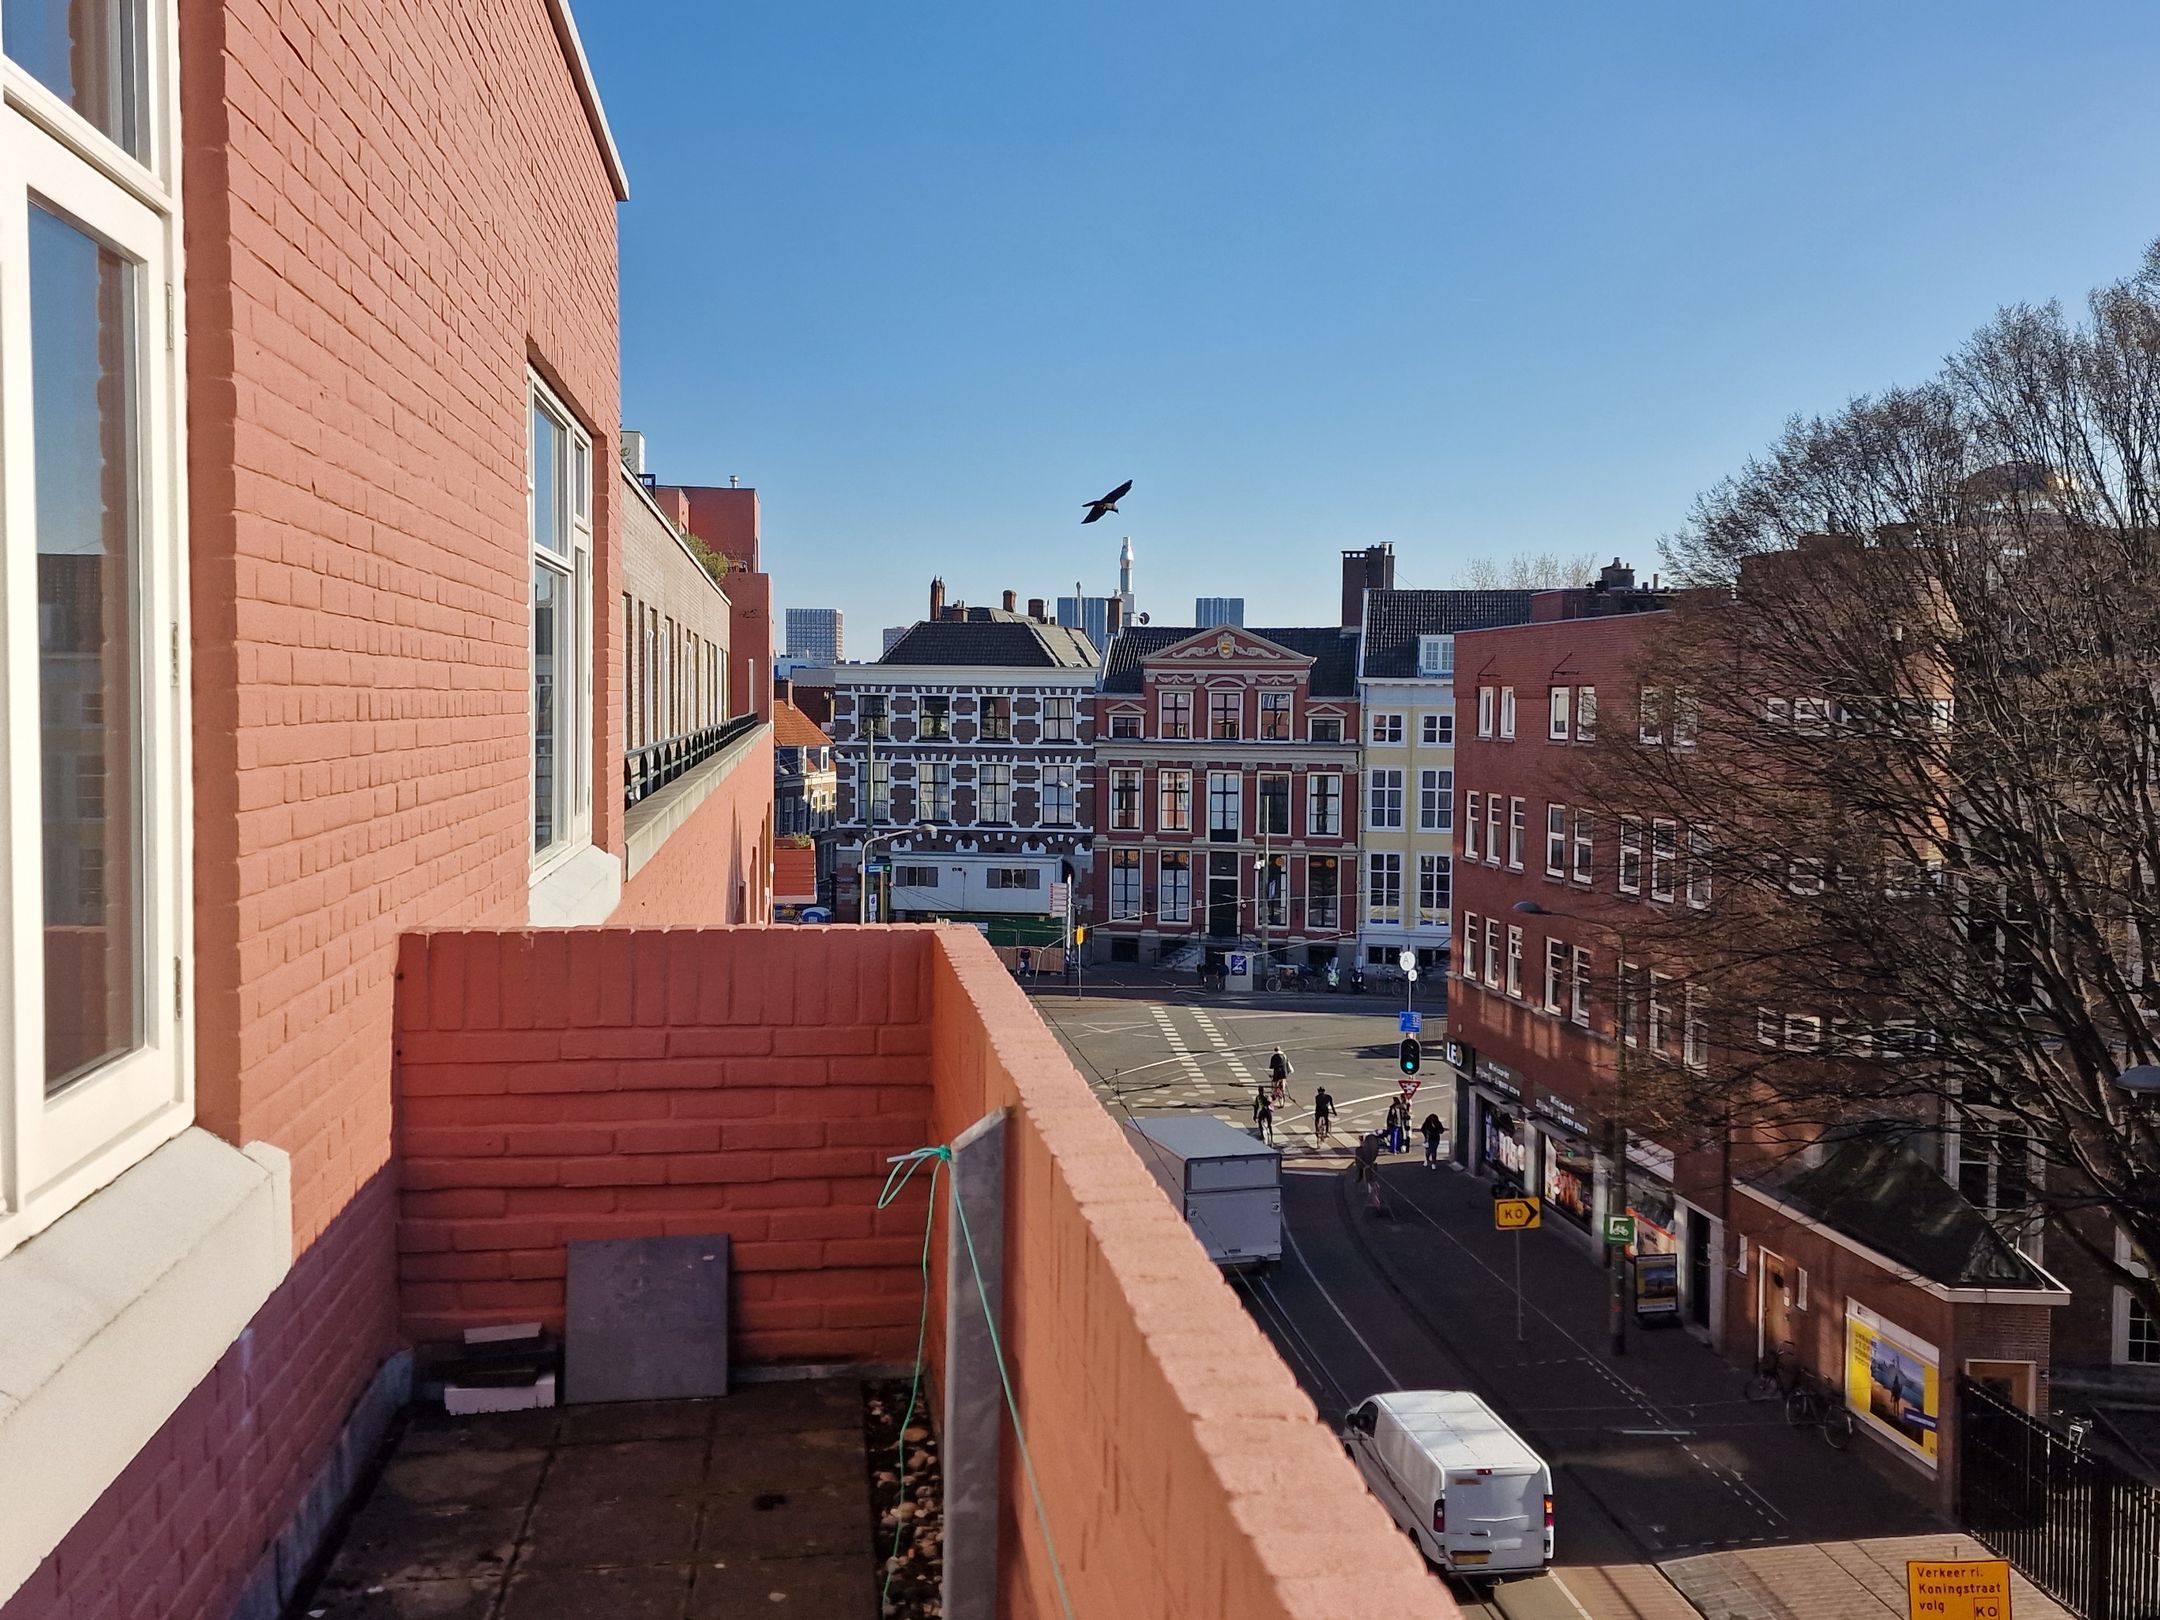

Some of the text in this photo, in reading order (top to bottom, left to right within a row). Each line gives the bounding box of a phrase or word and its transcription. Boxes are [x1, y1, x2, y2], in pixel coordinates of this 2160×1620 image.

[1917, 1567, 1966, 1578] Verkeer
[1919, 1583, 2001, 1597] Koningstraat
[1919, 1600, 1945, 1615] volg
